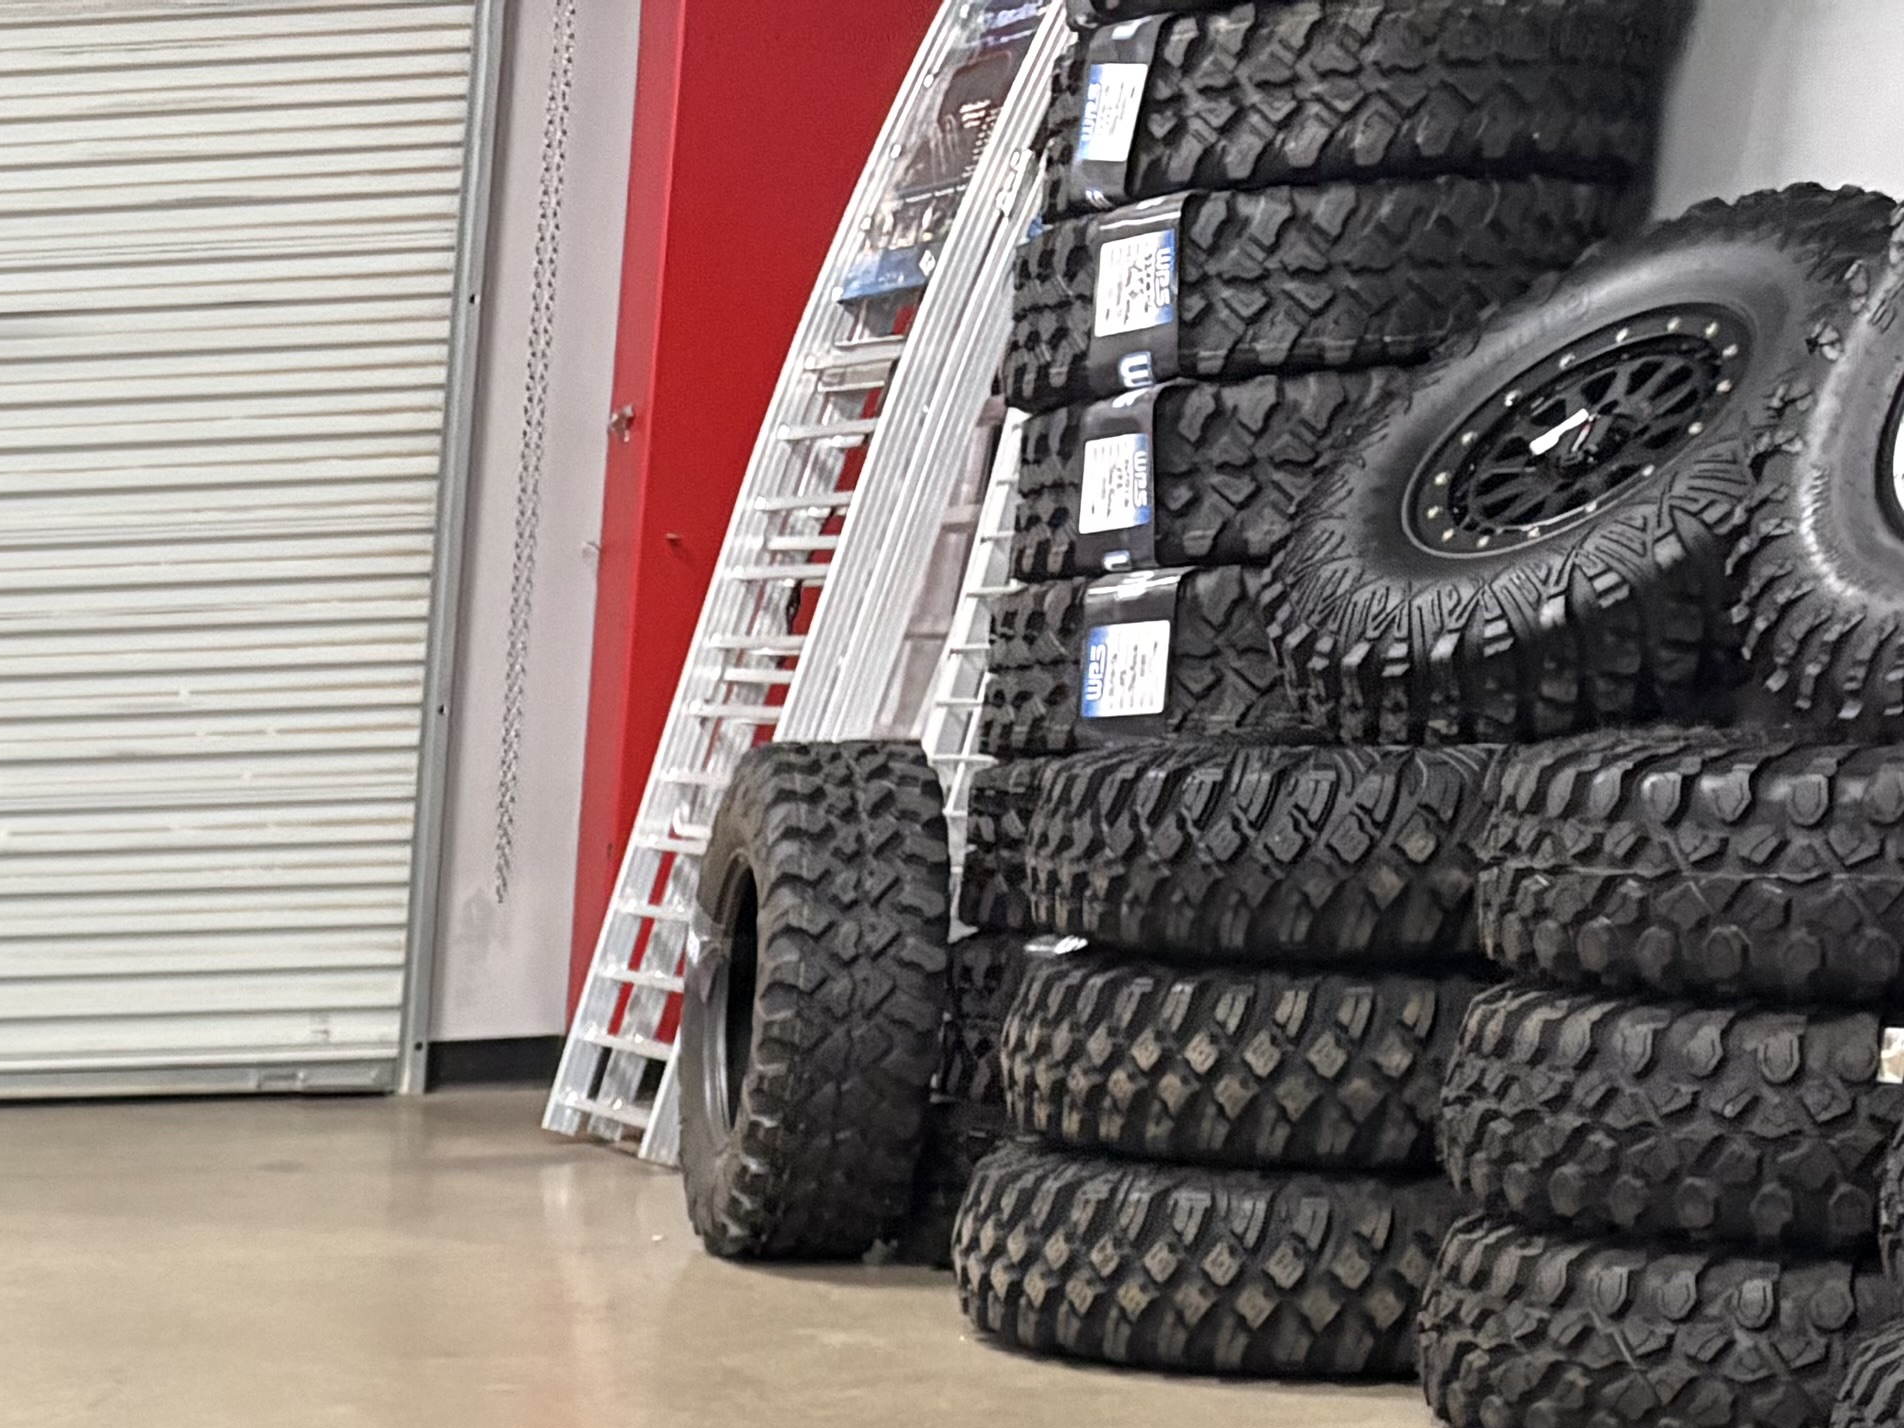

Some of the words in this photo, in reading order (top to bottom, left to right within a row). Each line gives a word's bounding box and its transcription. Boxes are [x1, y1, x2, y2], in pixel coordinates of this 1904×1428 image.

[1154, 247, 1172, 308] WPS
[1132, 449, 1149, 508] WPS
[1085, 643, 1108, 702] WPS
